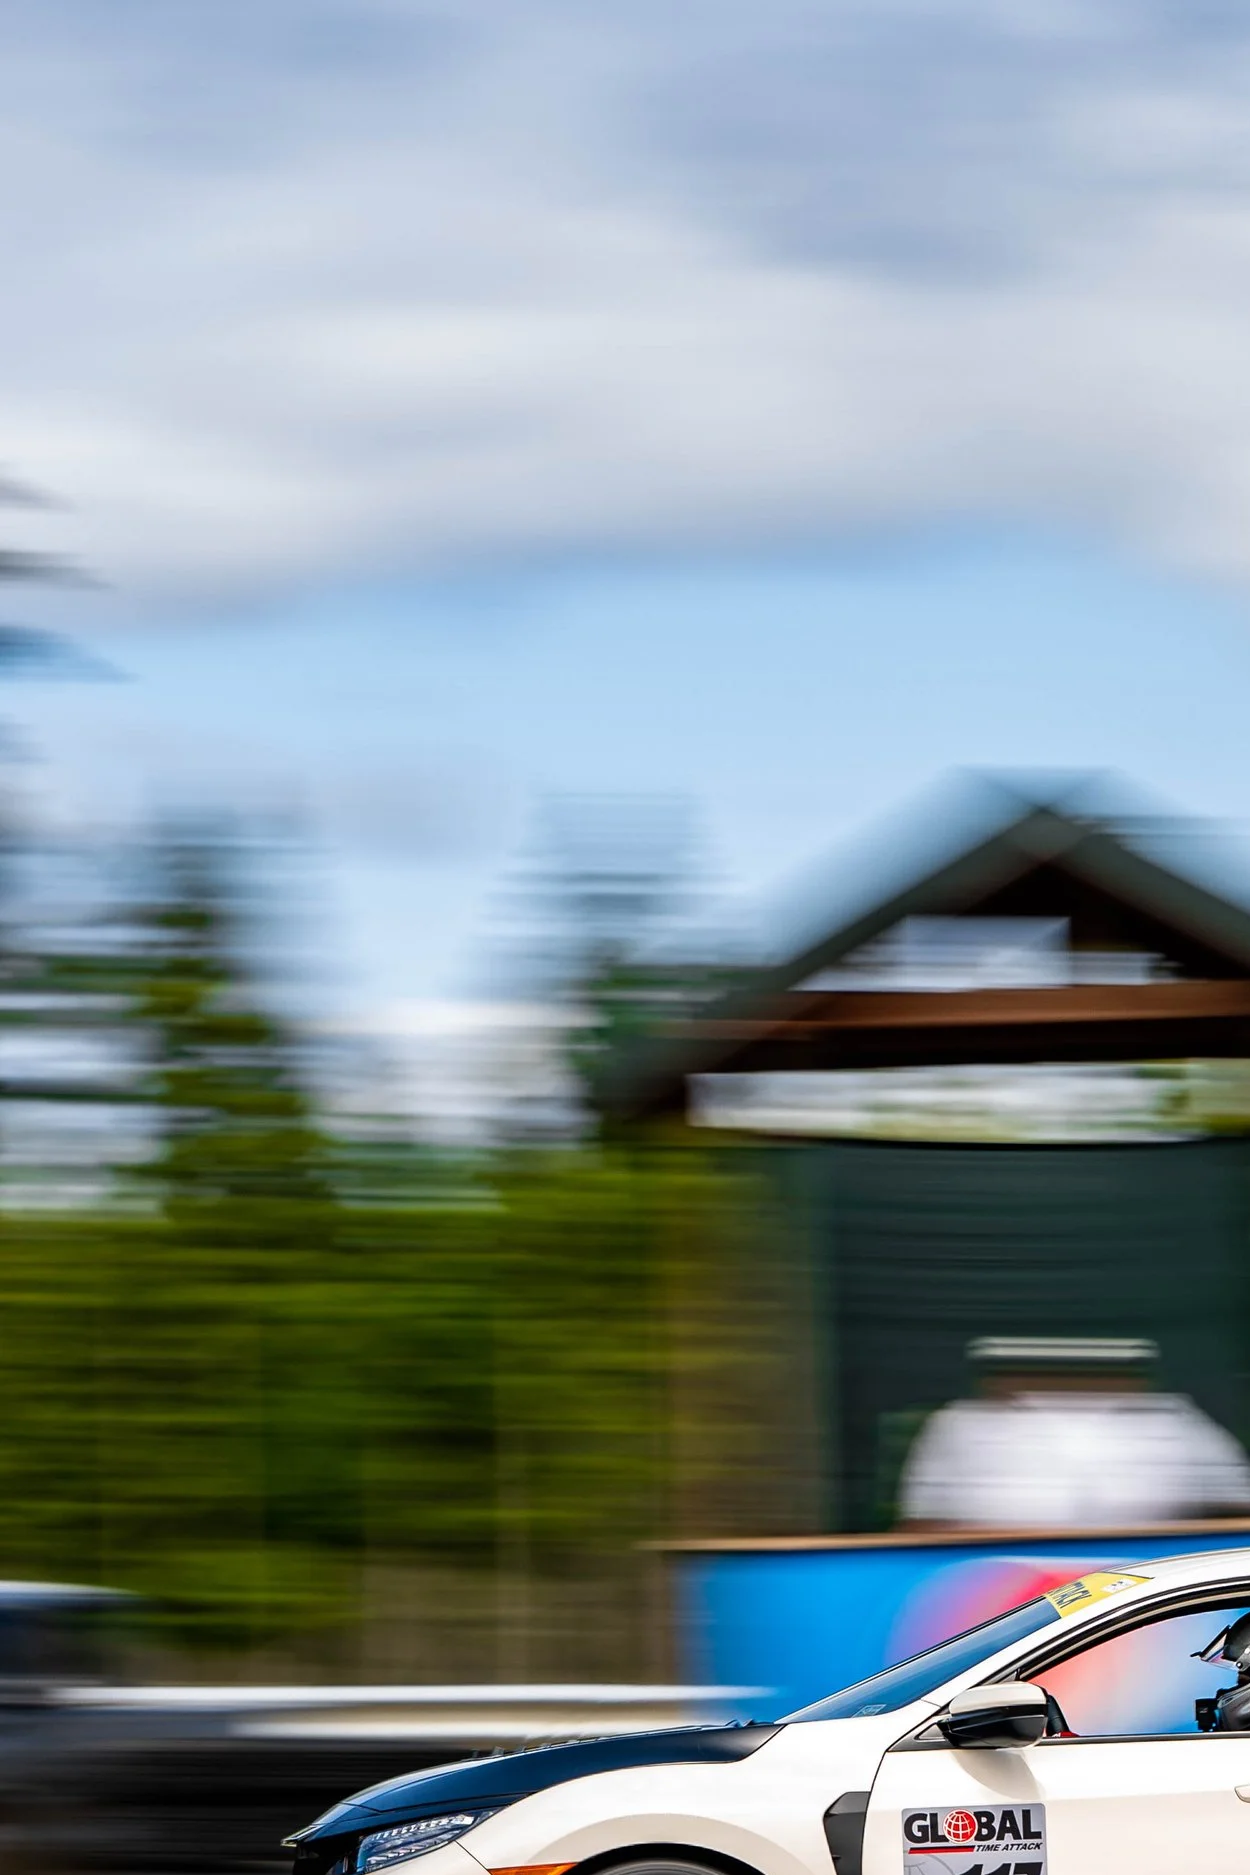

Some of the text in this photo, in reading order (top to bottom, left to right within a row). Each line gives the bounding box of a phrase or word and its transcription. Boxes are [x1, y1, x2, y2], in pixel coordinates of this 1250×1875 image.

[904, 1809, 1043, 1844] GLOBAL
[976, 1842, 1043, 1852] TIME ATTACK
